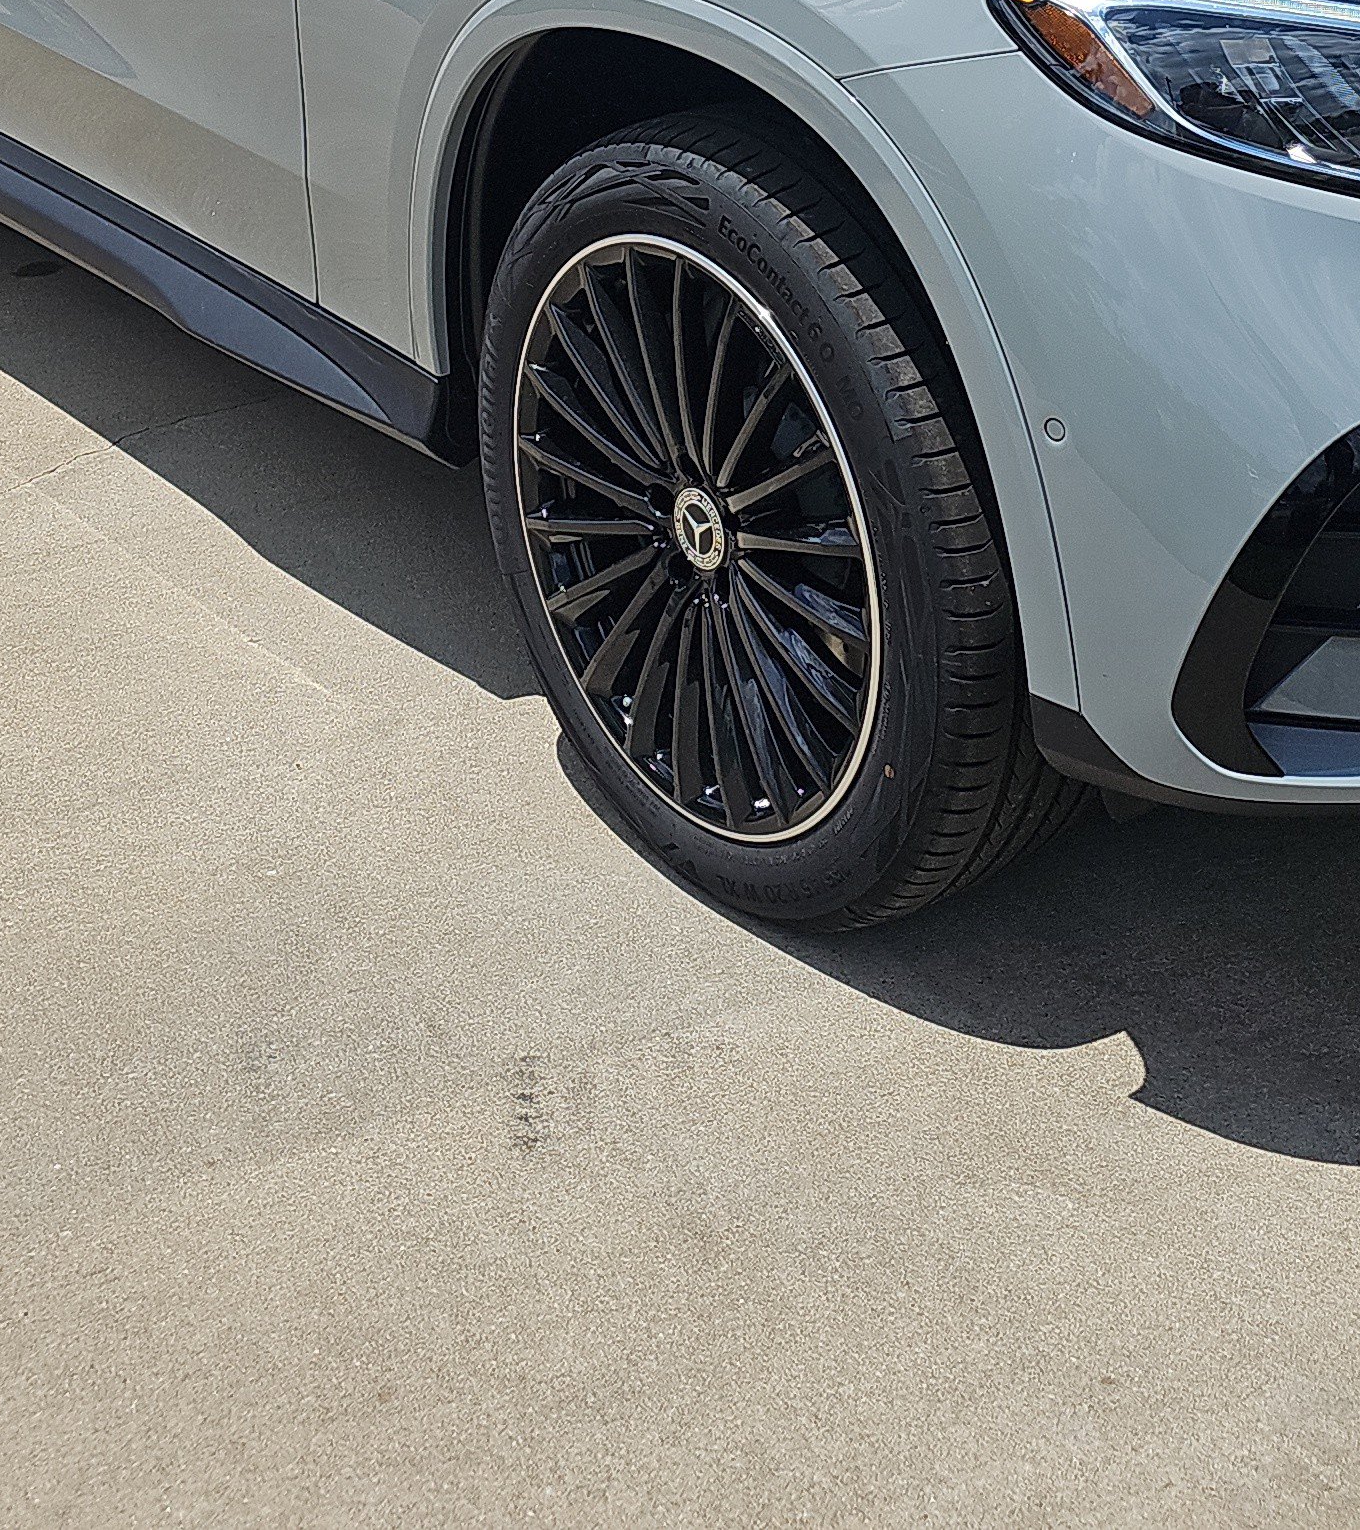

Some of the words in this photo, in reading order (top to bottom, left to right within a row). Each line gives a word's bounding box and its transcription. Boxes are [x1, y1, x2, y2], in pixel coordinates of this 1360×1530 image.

[718, 213, 811, 326] EcoContact
[807, 315, 823, 339] 6
[715, 873, 741, 900] XL
